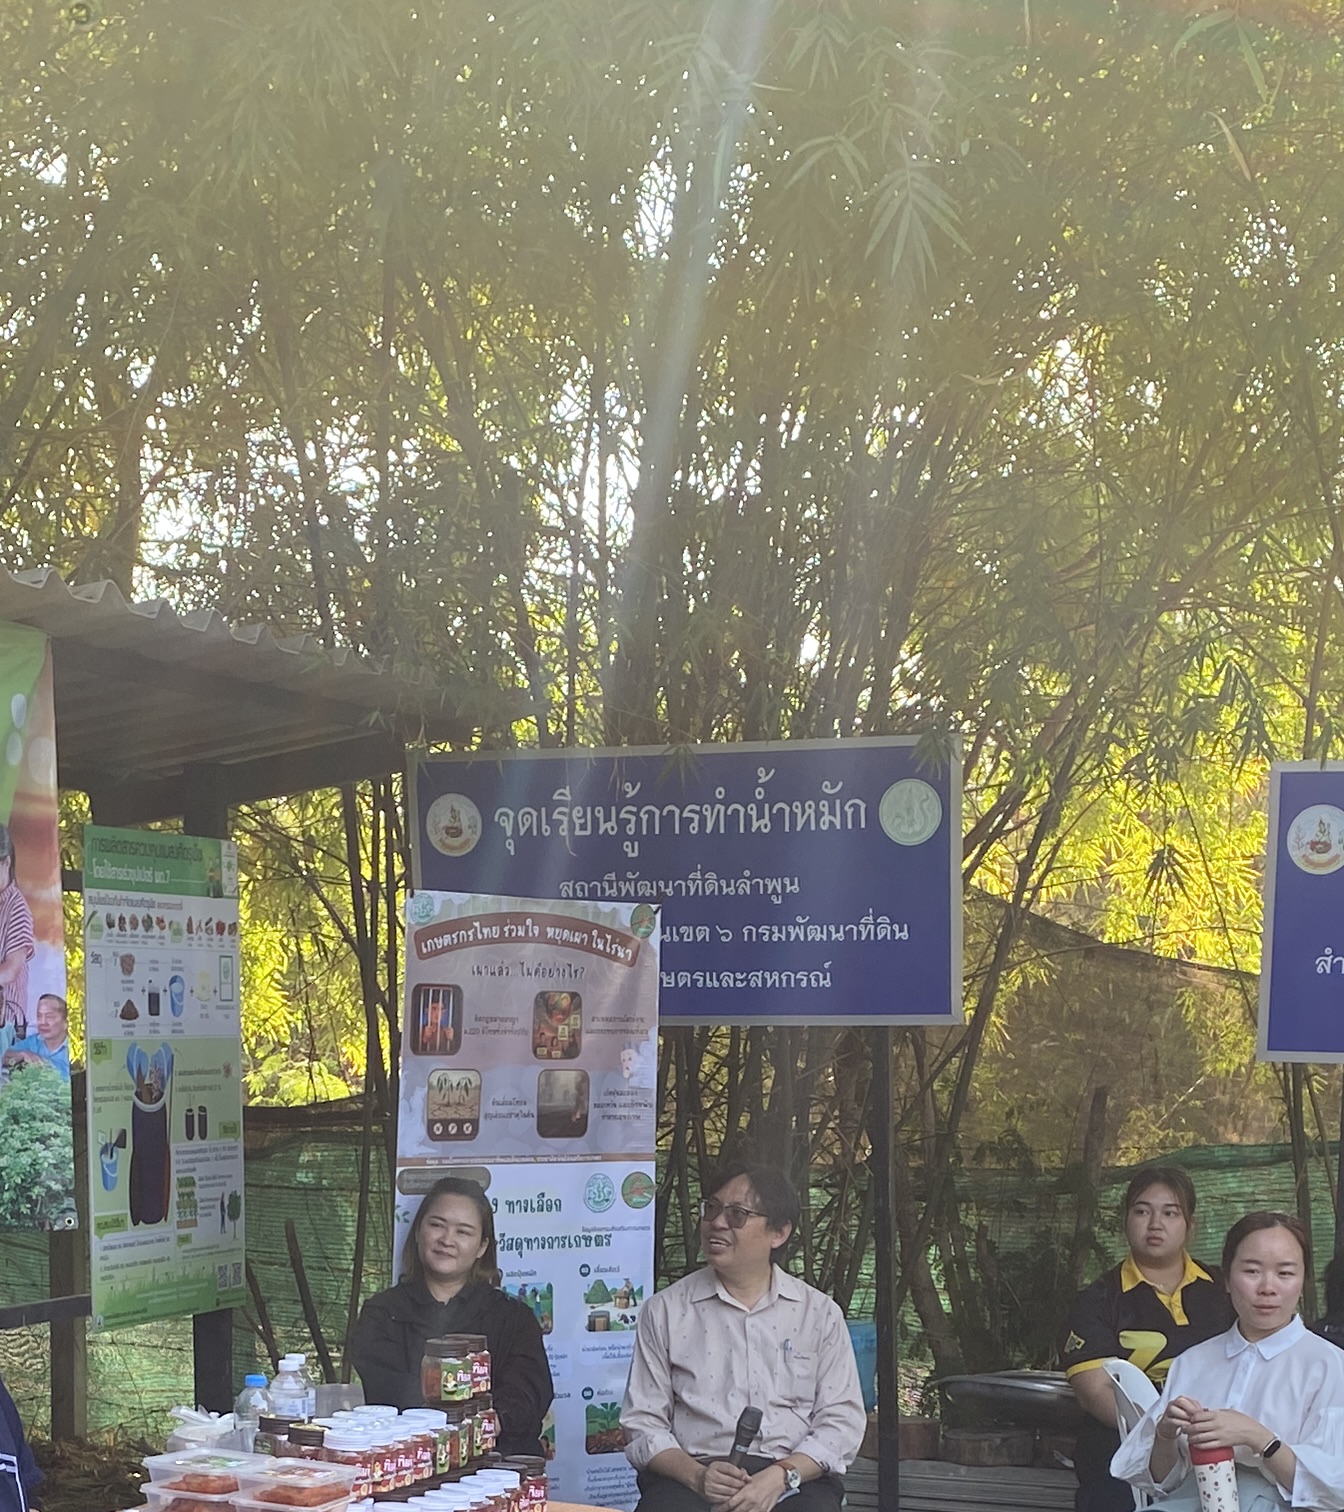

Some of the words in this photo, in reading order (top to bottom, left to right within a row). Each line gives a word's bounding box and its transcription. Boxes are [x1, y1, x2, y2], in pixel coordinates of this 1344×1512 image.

[494, 767, 868, 857] จุดเรียนรู้การทำน้ำหมัก
[559, 866, 800, 905] สถานีพัฒนาที่ดินลำพูน
[421, 921, 500, 954] เกษตรกรไทย
[503, 918, 540, 938] ร่วมใจ
[546, 925, 588, 946] หยุดเผา
[592, 930, 633, 962] ในไร่นา
[716, 925, 731, 944] ๖
[742, 908, 909, 943] กรมพัฒนาที่ดิน
[506, 1192, 562, 1214] ทางเลือก
[496, 1233, 612, 1258] วัสดุทางการเกษตร
